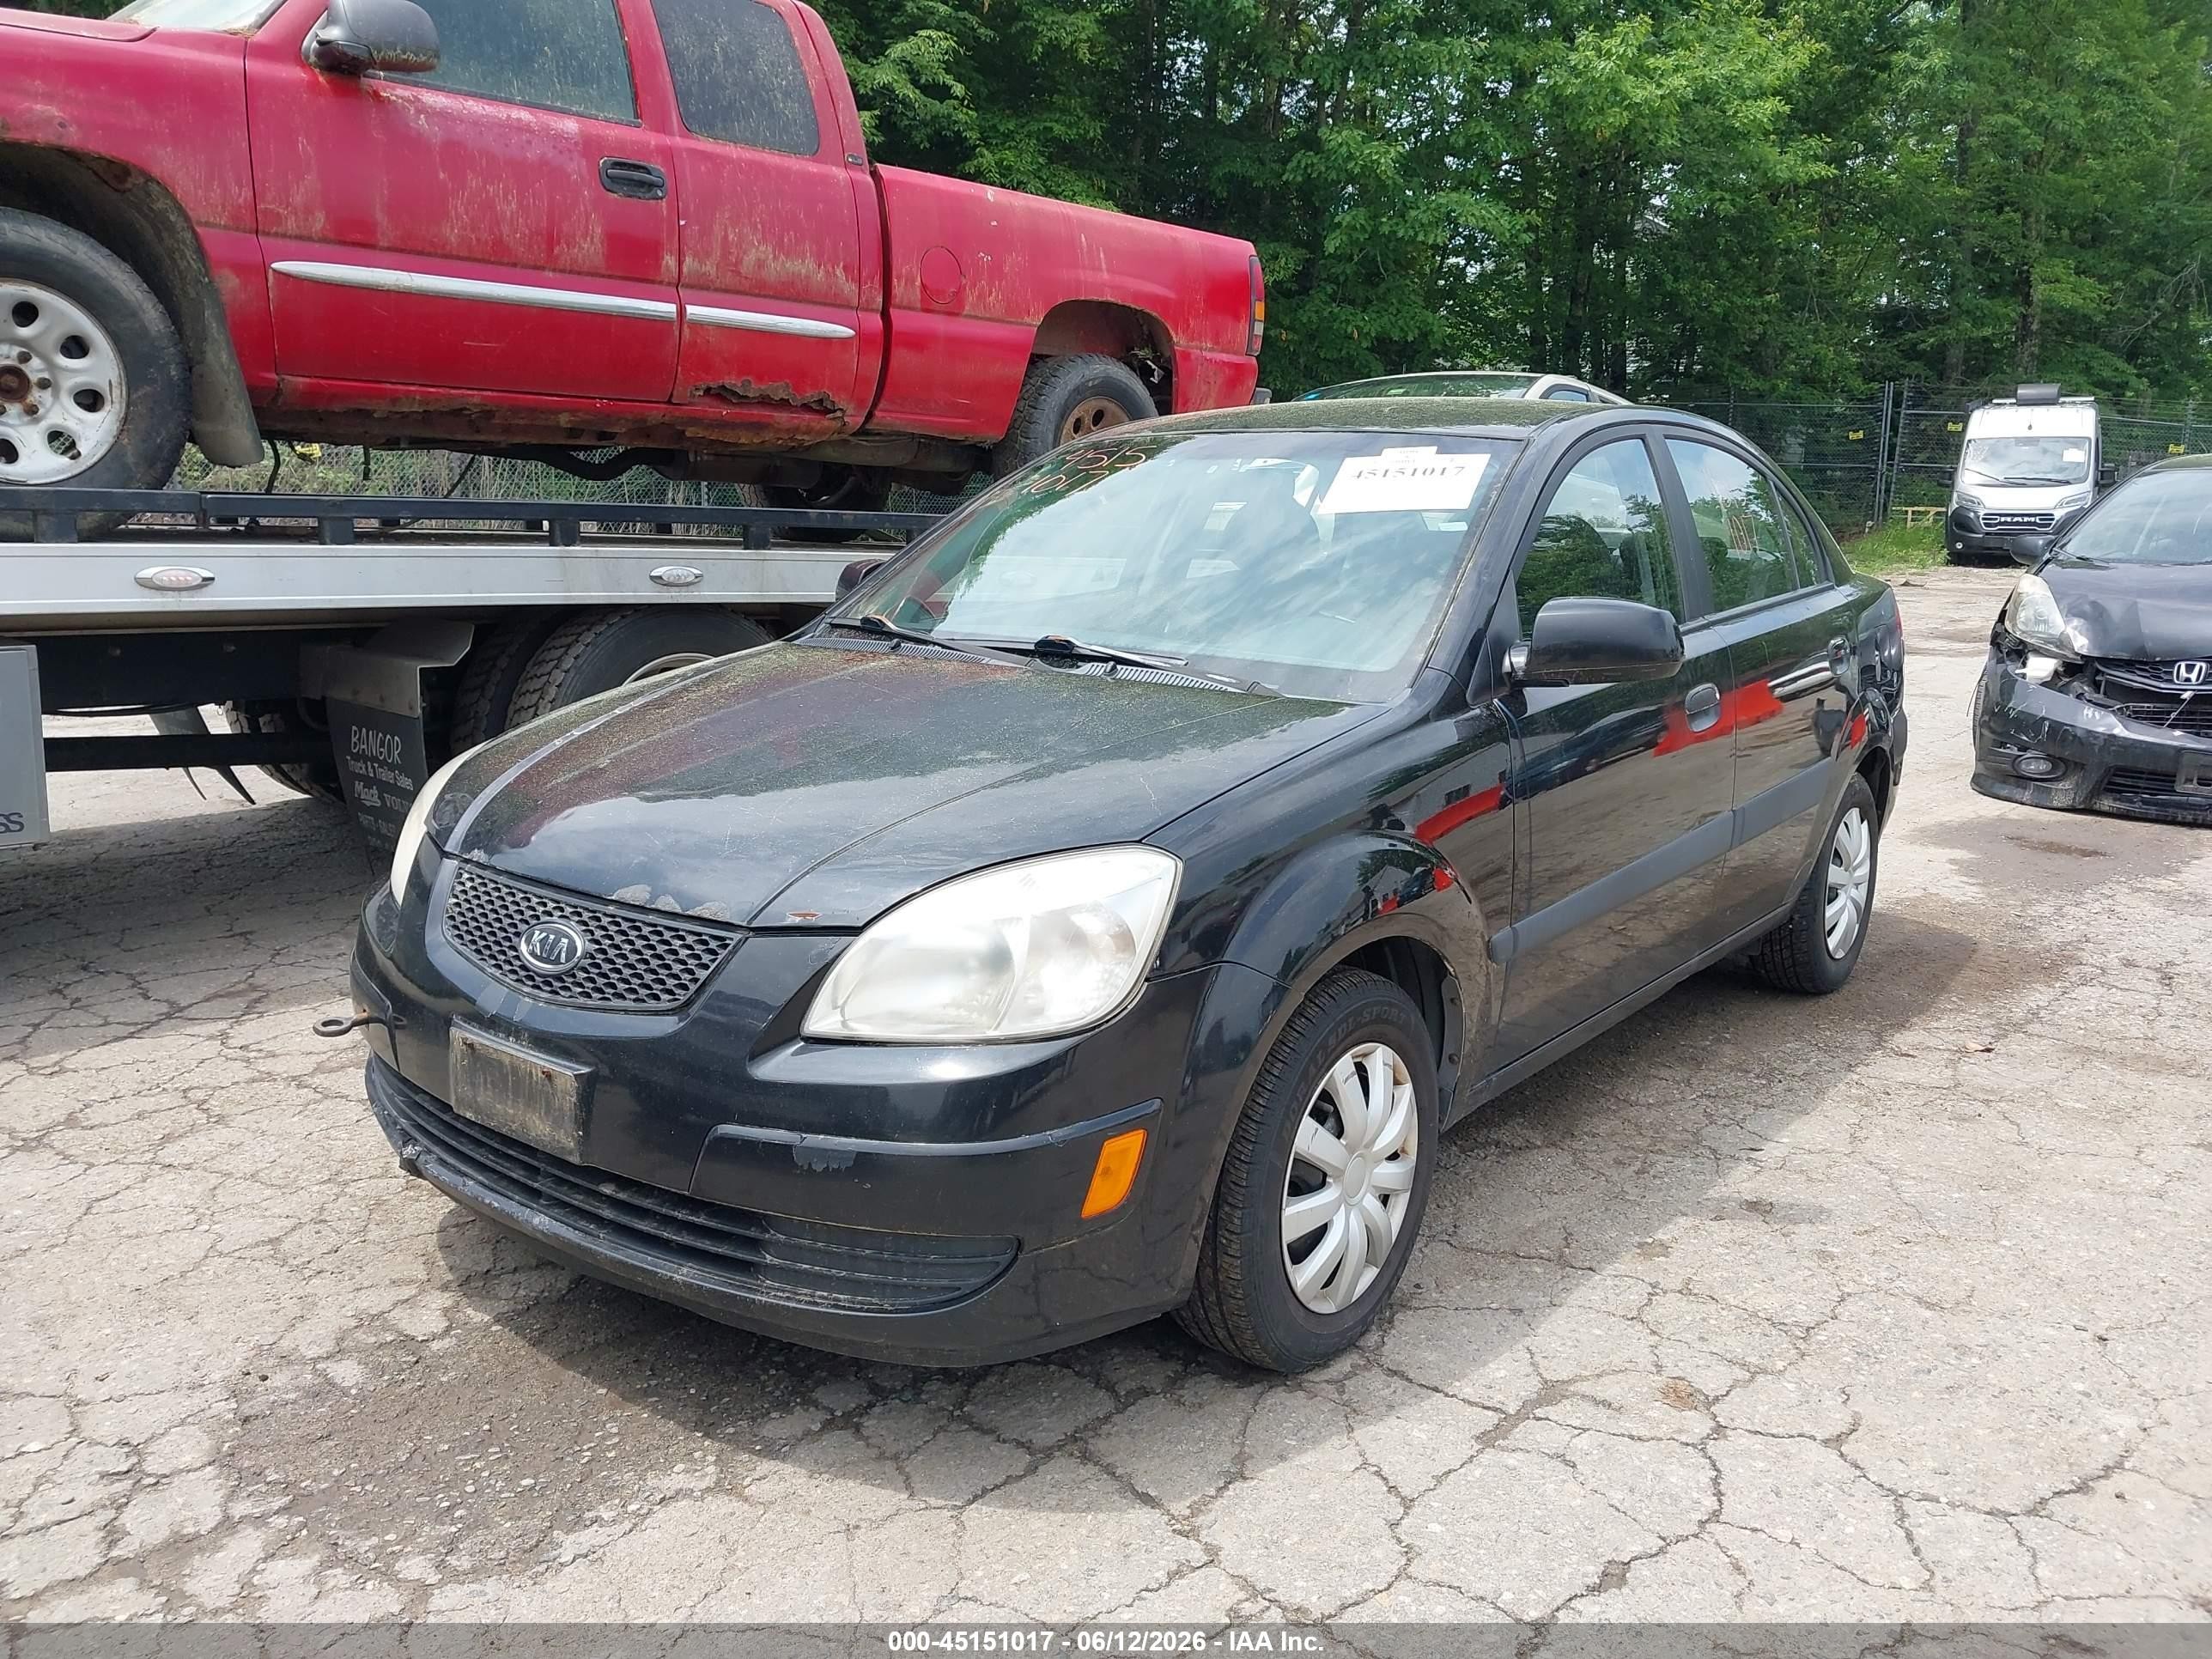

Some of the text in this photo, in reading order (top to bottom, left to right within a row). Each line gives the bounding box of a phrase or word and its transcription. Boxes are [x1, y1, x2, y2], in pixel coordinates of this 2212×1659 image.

[1060, 445, 1158, 471] 4515
[1351, 465, 1467, 480] 45151017
[1021, 471, 1109, 496] 1017
[350, 725, 403, 764] BANGOR
[345, 756, 414, 791] Truck & Trailer Sales
[354, 781, 412, 812] Mack VOLV
[527, 930, 568, 963] KIA
